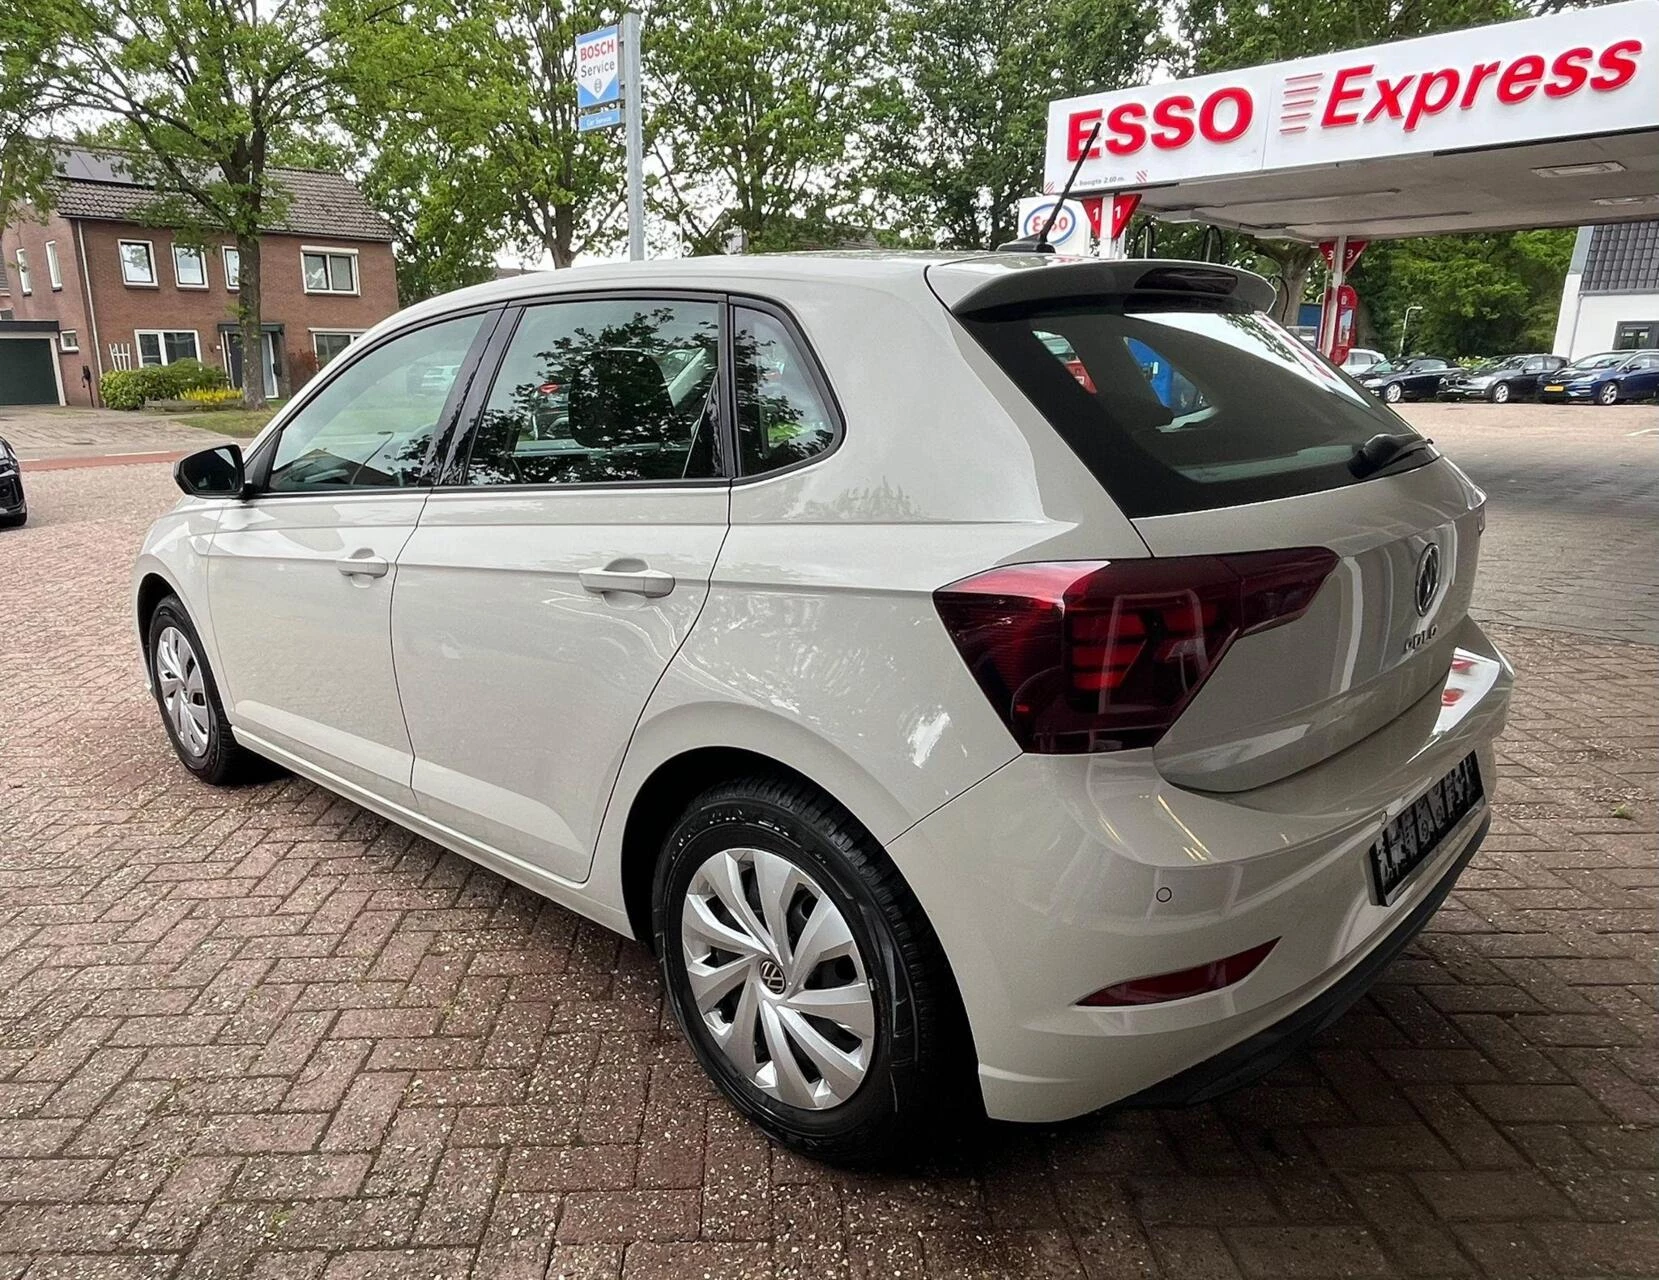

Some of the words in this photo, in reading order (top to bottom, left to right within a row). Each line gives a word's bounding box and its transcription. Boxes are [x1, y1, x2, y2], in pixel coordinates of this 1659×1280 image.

[580, 39, 615, 61] BOSCH
[580, 60, 615, 78] Service
[1066, 86, 1254, 162] ESSO
[1320, 39, 1643, 132] Express
[1092, 207, 1100, 221] 1
[1114, 205, 1122, 219] 1
[1327, 250, 1334, 260] 3
[1346, 249, 1354, 259] 3
